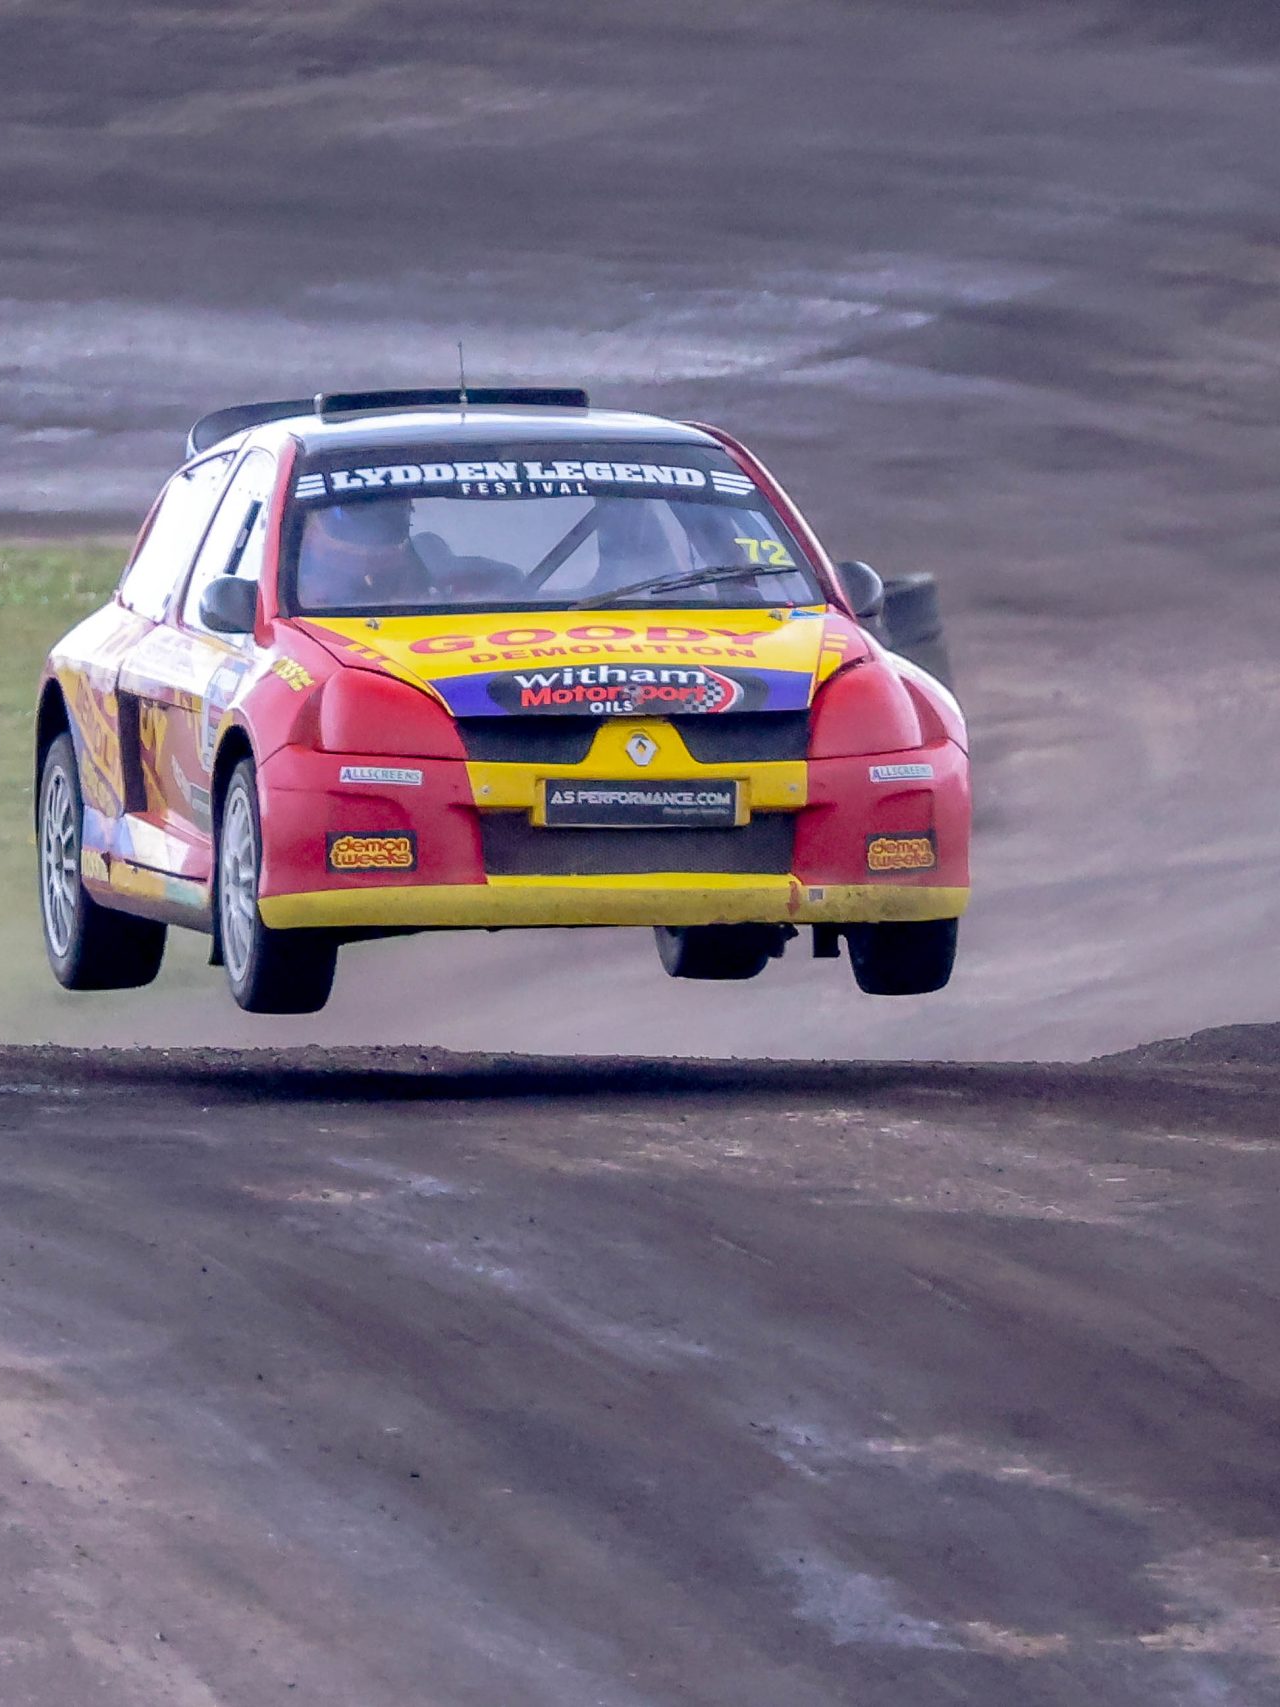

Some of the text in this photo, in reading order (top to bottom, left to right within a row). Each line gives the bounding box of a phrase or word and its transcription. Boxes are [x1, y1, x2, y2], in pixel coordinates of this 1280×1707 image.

[331, 461, 706, 490] LYDDEN LEGEND
[461, 481, 589, 495] FESTIVAL
[734, 537, 797, 567] 72
[408, 625, 773, 654] GOODY
[469, 643, 757, 664] DEMOLITION
[514, 665, 705, 688] witham
[589, 700, 634, 714] OILS
[341, 768, 420, 782] ALLSCREENS
[335, 837, 410, 854] demon
[332, 851, 412, 867] tweeks
